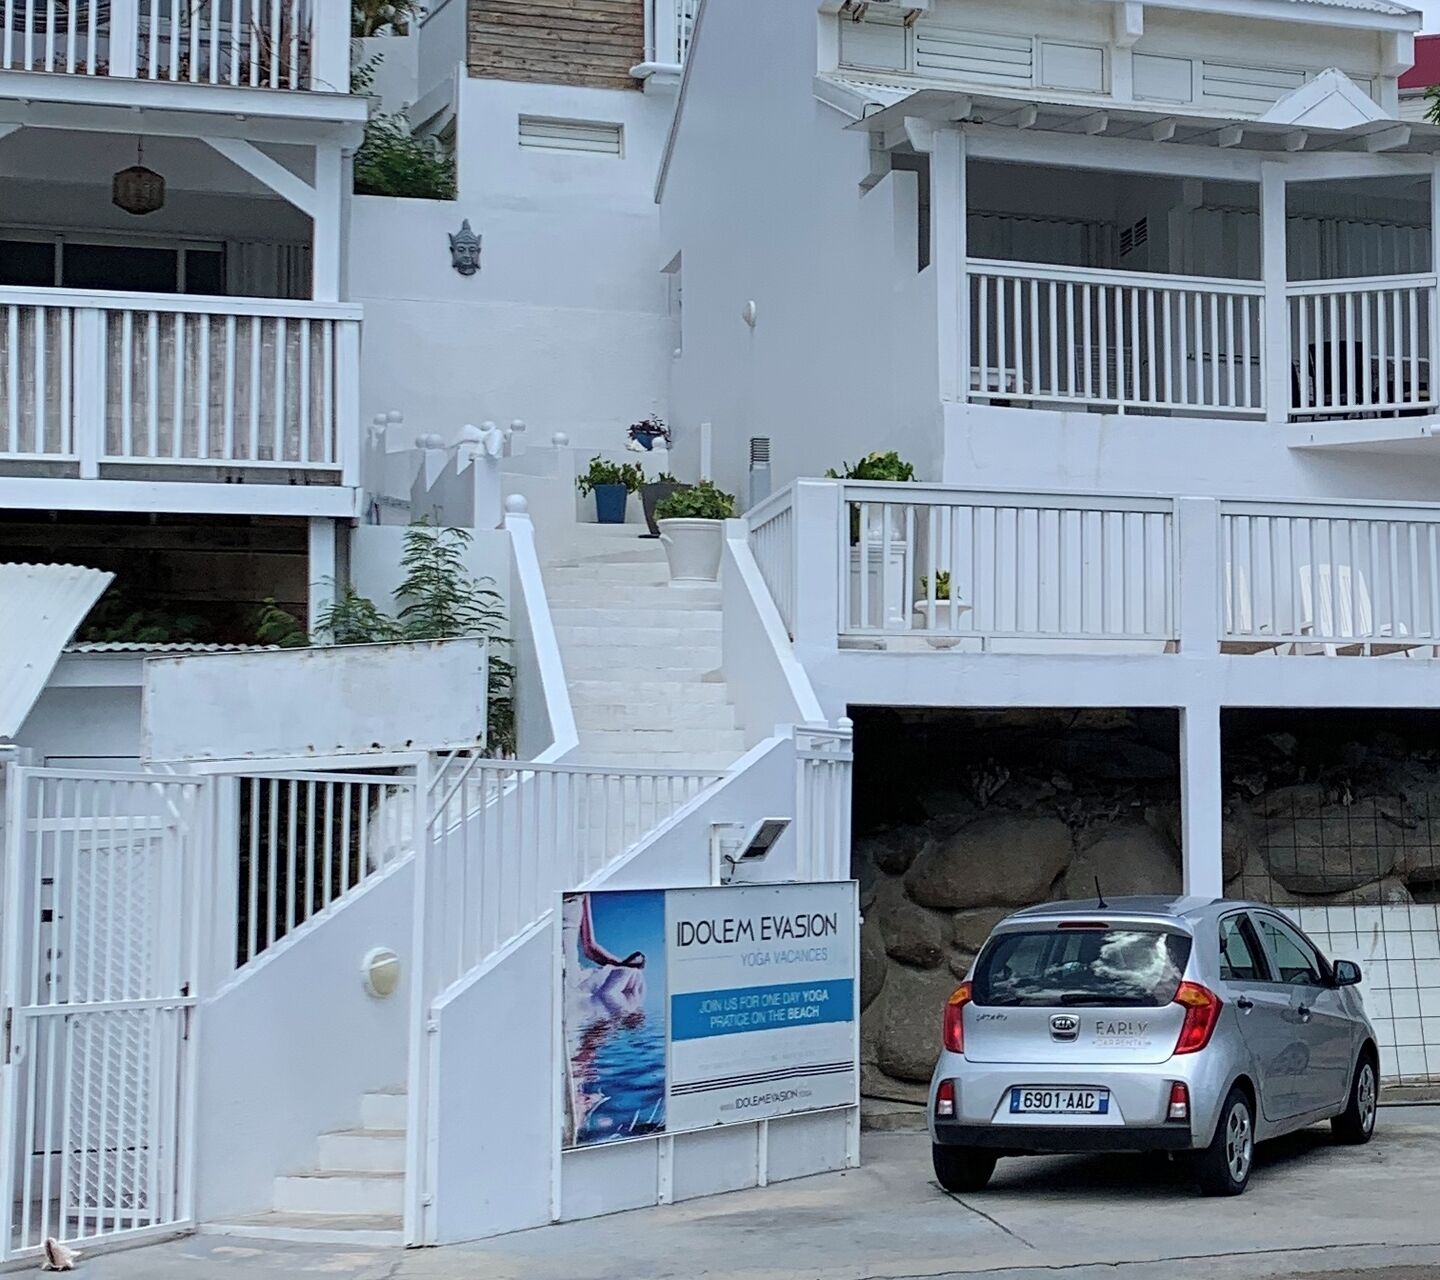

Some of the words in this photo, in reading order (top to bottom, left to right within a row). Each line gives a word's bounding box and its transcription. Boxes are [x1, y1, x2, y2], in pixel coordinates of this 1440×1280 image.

[677, 919, 755, 947] IDOLEM
[761, 912, 837, 941] EVASION
[740, 951, 771, 967] YOGA
[774, 947, 828, 964] VACANCES
[700, 1000, 722, 1014] JOIN
[724, 998, 738, 1010] US
[740, 995, 759, 1009] FOR
[761, 993, 780, 1007] ONE
[783, 991, 801, 1004] DAY
[802, 989, 829, 1002] YOGA
[751, 1011, 766, 1025] ON
[768, 1009, 785, 1022] THE
[787, 1005, 820, 1020] BEACH
[1055, 1019, 1073, 1028] KIA
[1096, 1021, 1149, 1035] EARLY
[1024, 1092, 1095, 1109] 6901-AAD
